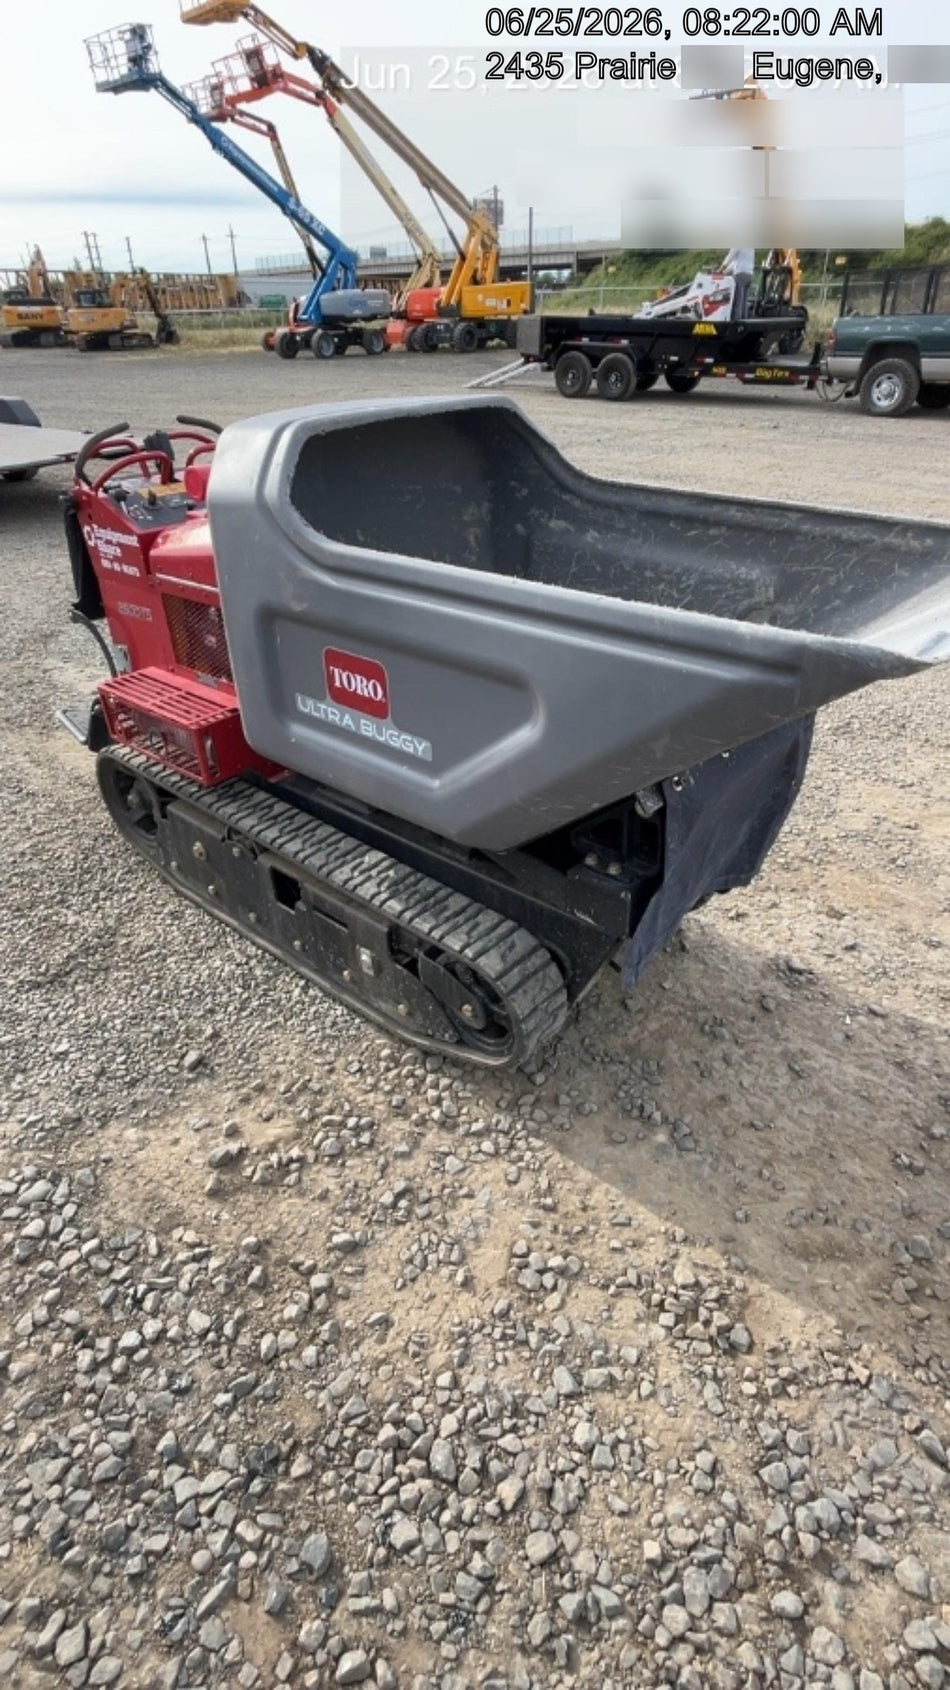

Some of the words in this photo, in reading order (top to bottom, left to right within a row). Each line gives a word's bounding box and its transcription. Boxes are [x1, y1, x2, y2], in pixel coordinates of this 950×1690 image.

[330, 666, 384, 702] TORO
[298, 694, 356, 731] ULTRA
[359, 718, 426, 756] BUGGY
